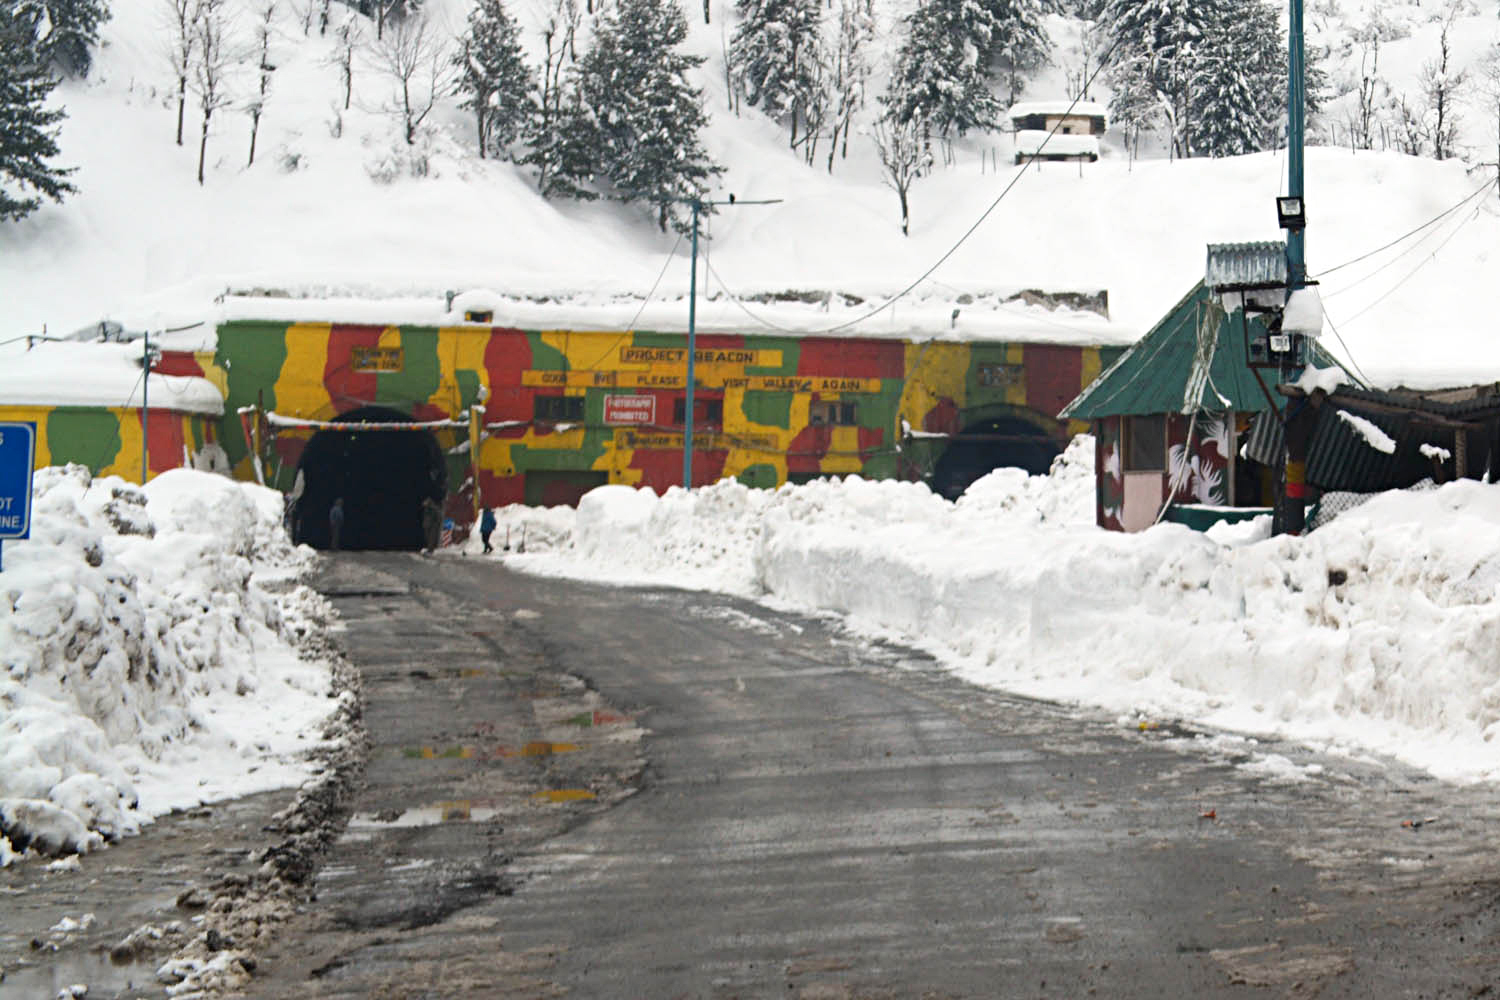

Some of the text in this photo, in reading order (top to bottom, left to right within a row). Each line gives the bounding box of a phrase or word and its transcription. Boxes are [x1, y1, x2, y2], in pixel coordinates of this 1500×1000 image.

[626, 350, 753, 363] PROJECT BEACON
[637, 375, 680, 386] PLEASE
[723, 377, 750, 389] VISIT
[763, 378, 801, 389] VALLEY
[821, 379, 861, 391] AGAIN
